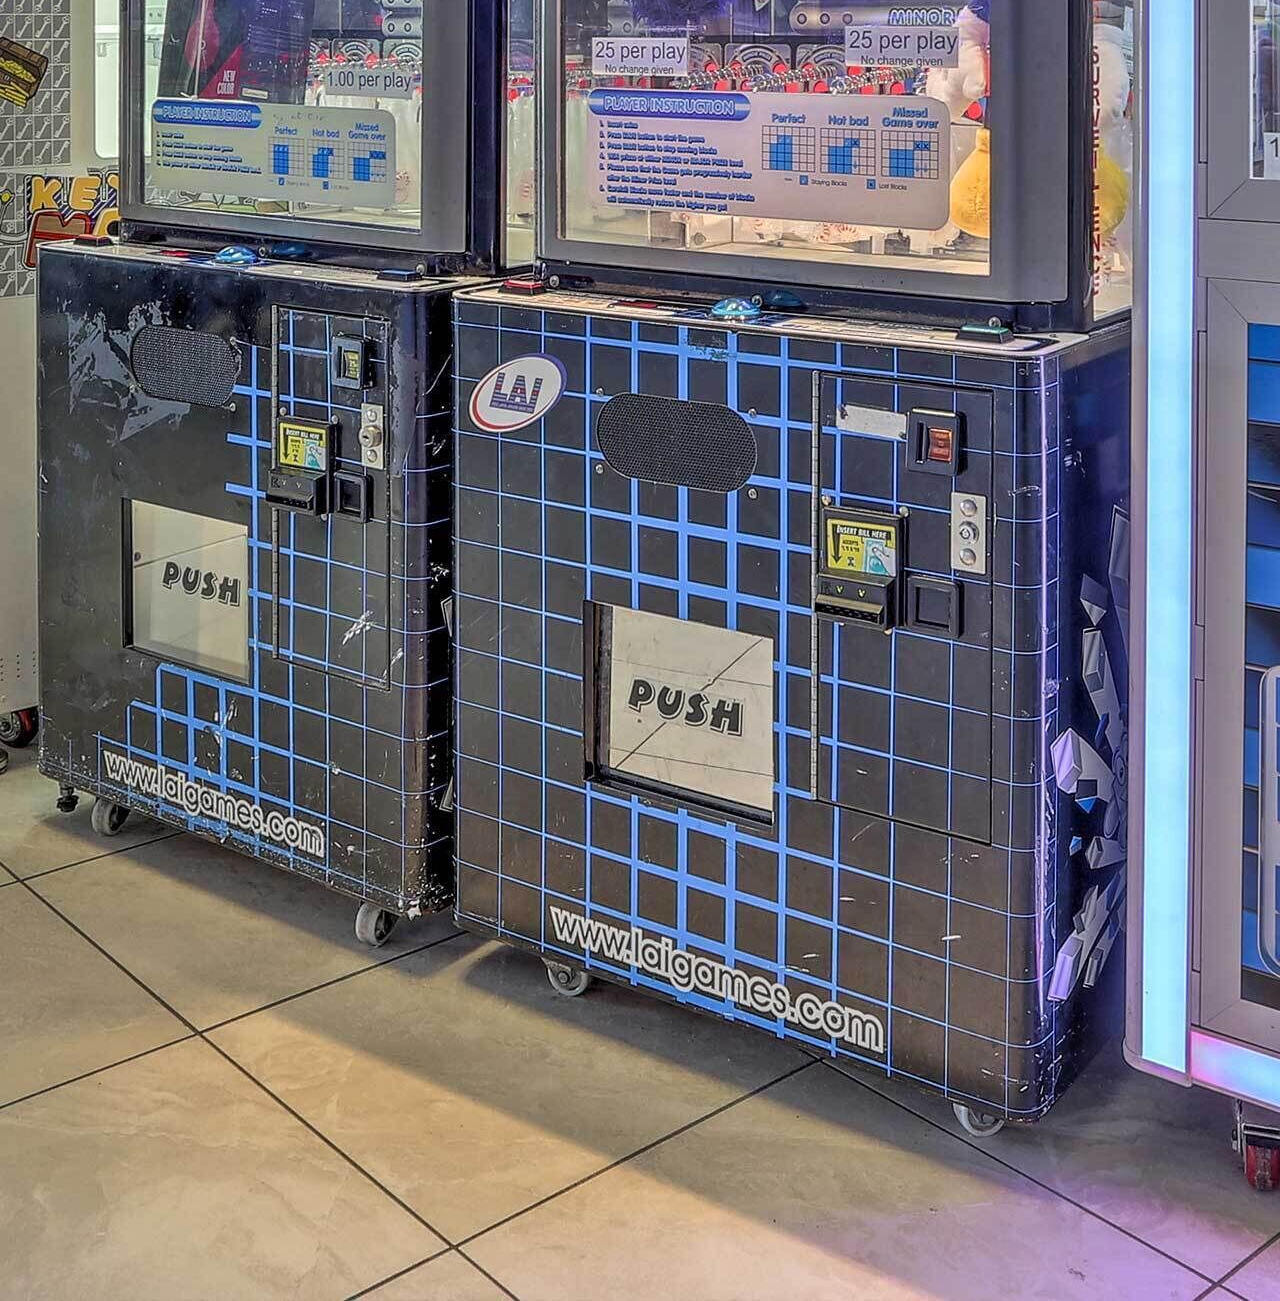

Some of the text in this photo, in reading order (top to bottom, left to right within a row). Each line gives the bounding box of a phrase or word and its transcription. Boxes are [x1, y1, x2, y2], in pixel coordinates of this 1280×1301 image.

[889, 9, 955, 26] MINOR
[849, 30, 958, 55] 25 per play
[595, 40, 687, 64] 25 per play
[860, 55, 944, 67] No change given
[605, 65, 673, 75] No change given
[328, 71, 412, 91] 1.00 per play
[162, 106, 194, 121] PLAYER
[604, 96, 734, 115] PLAYER INSTRUCTION
[892, 107, 928, 118] Missed
[772, 113, 806, 125] Perfect
[828, 115, 869, 127] Not bad
[882, 118, 939, 129] Game over
[274, 126, 298, 136] Perfect
[837, 525, 887, 539] INSERT BILL HERE
[163, 562, 240, 607] PUSH
[628, 679, 743, 737] PUSH
[104, 750, 324, 858] www.laigames.com
[550, 905, 886, 1055] www.laigames.com
